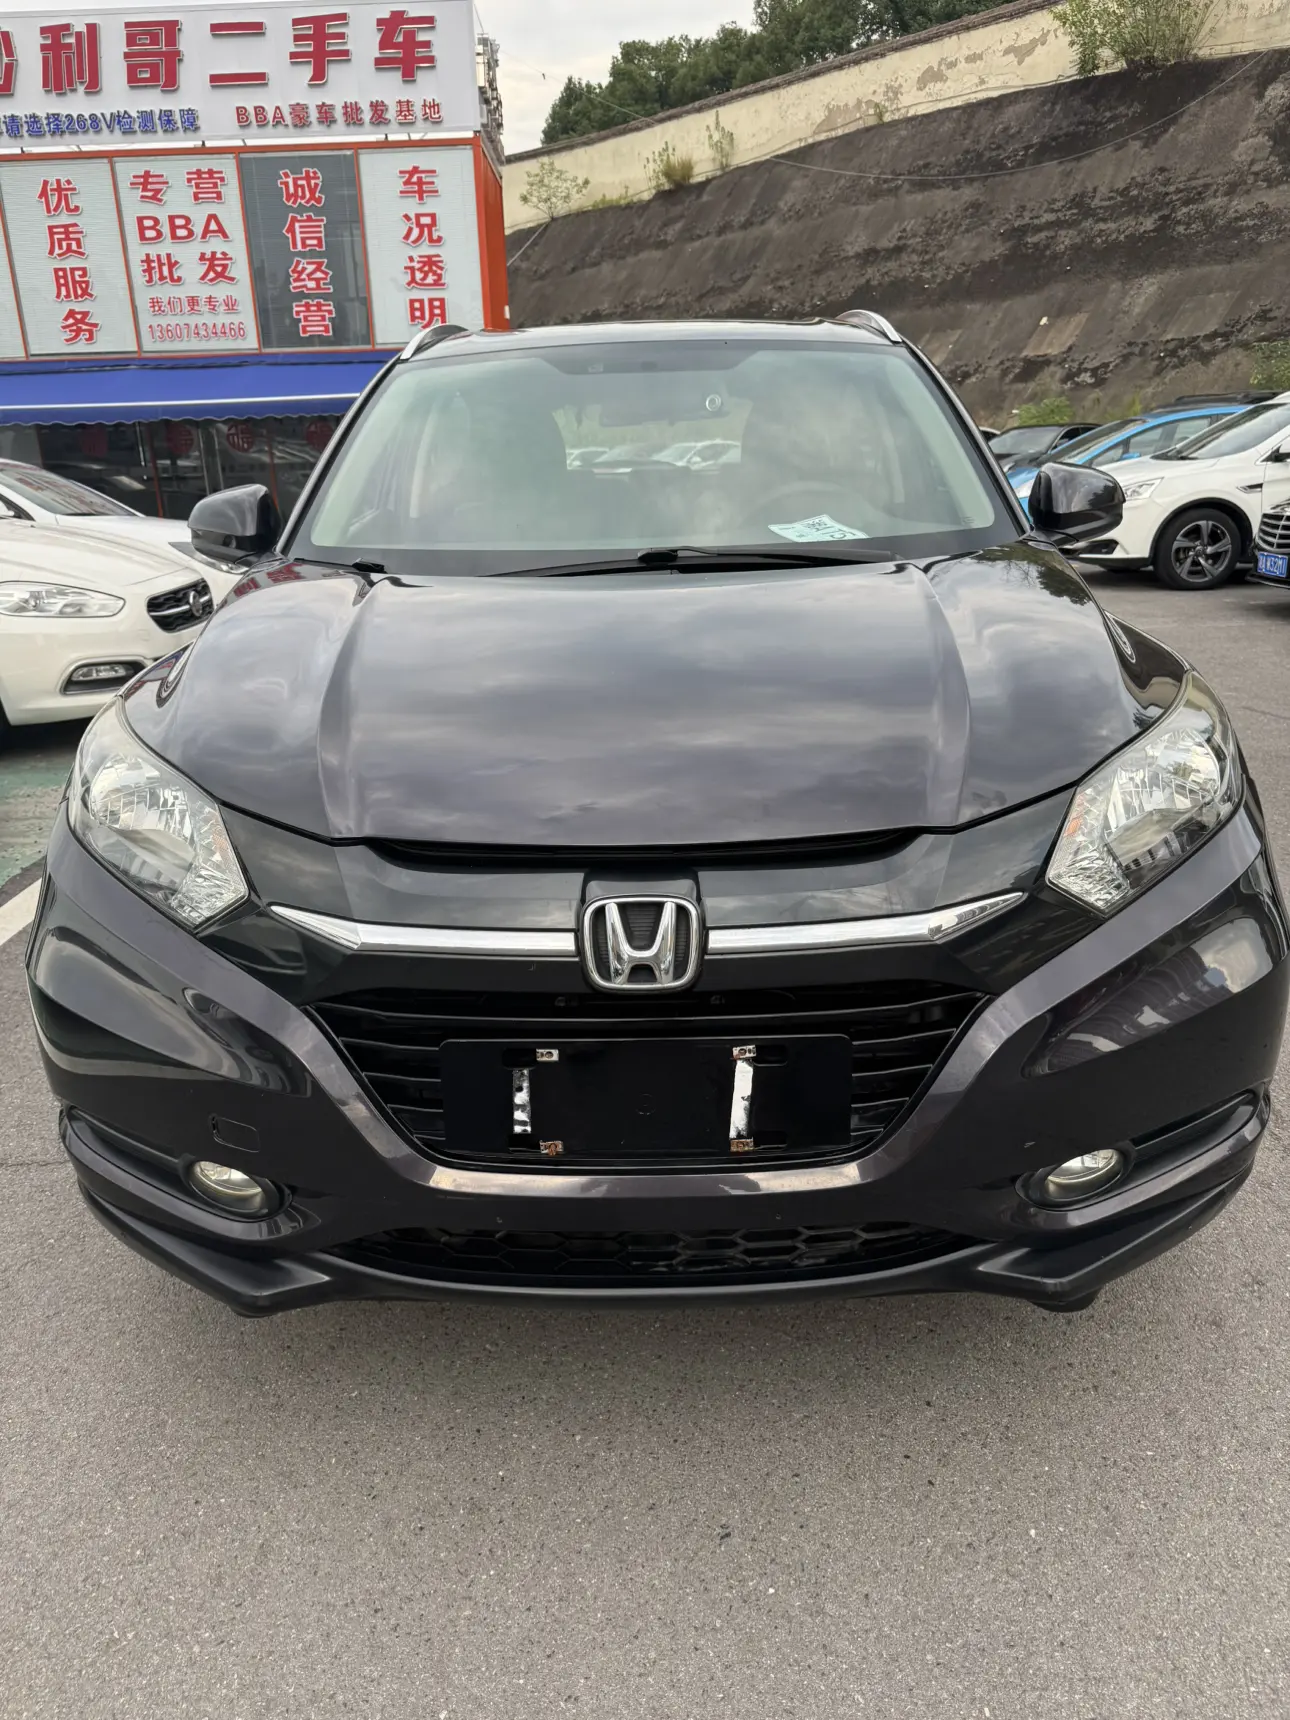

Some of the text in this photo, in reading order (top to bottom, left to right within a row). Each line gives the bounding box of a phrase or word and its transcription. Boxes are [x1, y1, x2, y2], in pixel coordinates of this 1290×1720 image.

[0, 108, 199, 137] 请选择268V检测保障
[236, 99, 443, 126] BBA豪车批发基地
[129, 168, 227, 205] 专营
[136, 214, 231, 244] BBA
[37, 178, 100, 344] 优质服务
[278, 168, 336, 337] 诚信经营
[398, 165, 449, 330] 车况透明
[141, 251, 238, 286] 批发
[148, 294, 239, 315] 我们更专业
[148, 321, 246, 340] 13607434466
